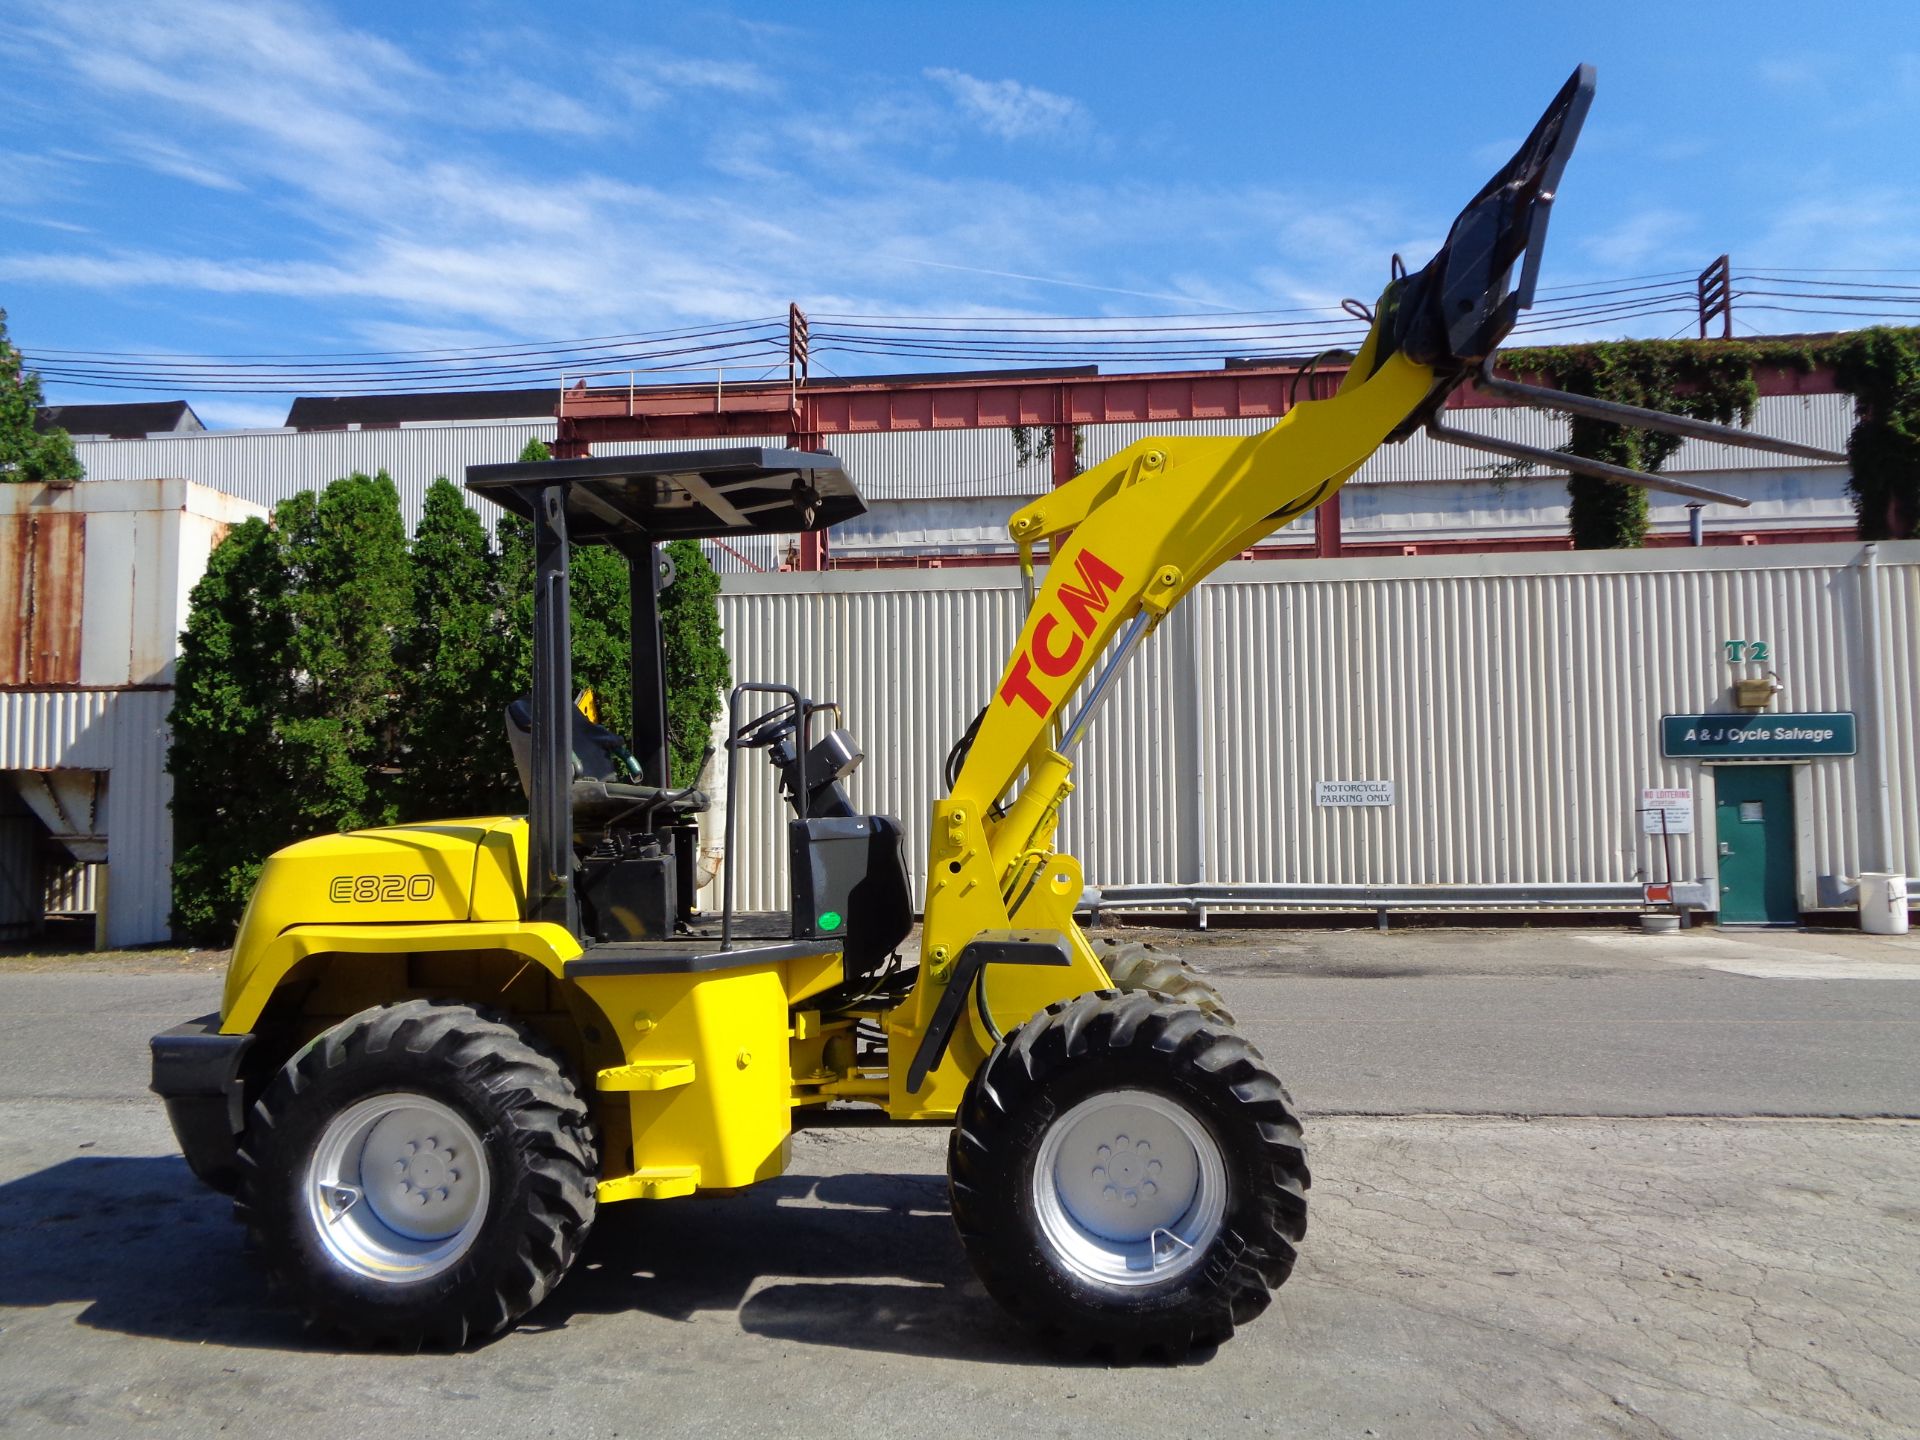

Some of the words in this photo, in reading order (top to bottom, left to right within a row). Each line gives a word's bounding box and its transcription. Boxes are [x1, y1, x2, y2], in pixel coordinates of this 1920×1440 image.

[1000, 548, 1125, 720] TCM
[1684, 729, 1697, 741] A
[1700, 730, 1711, 741] &
[1713, 729, 1723, 741] J
[1727, 728, 1770, 743] Cycle
[1774, 727, 1834, 743] Salvage
[1323, 784, 1387, 792] MOTORCYCLE
[1320, 794, 1363, 802] PARKING
[1366, 794, 1391, 802] ONLY
[1644, 790, 1653, 799] NO
[1656, 790, 1690, 798] LOITERING
[329, 874, 435, 903] E820
